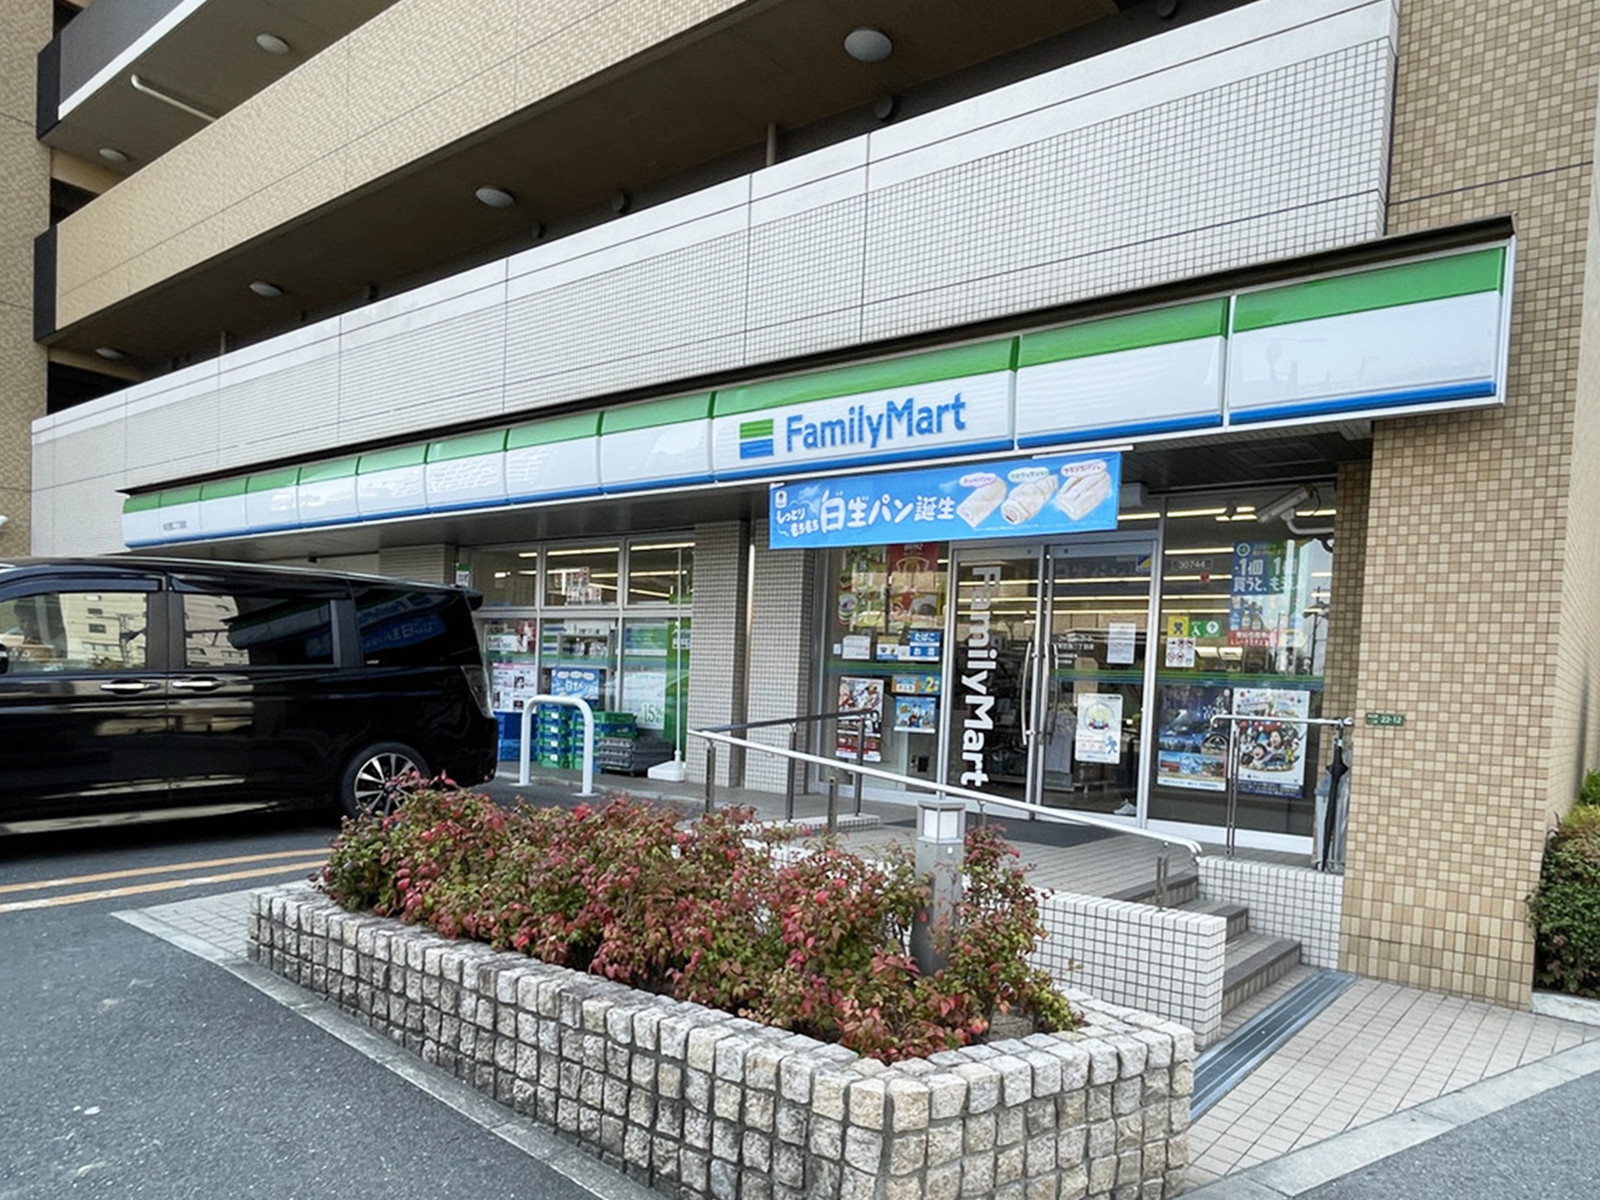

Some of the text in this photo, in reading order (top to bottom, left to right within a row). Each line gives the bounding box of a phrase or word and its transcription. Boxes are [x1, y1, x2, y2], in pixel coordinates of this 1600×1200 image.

[786, 392, 967, 452] FamilyMart
[777, 507, 806, 525] しっとり
[820, 489, 956, 533] 白生パン誕生
[960, 566, 1002, 787] FamilyMart
